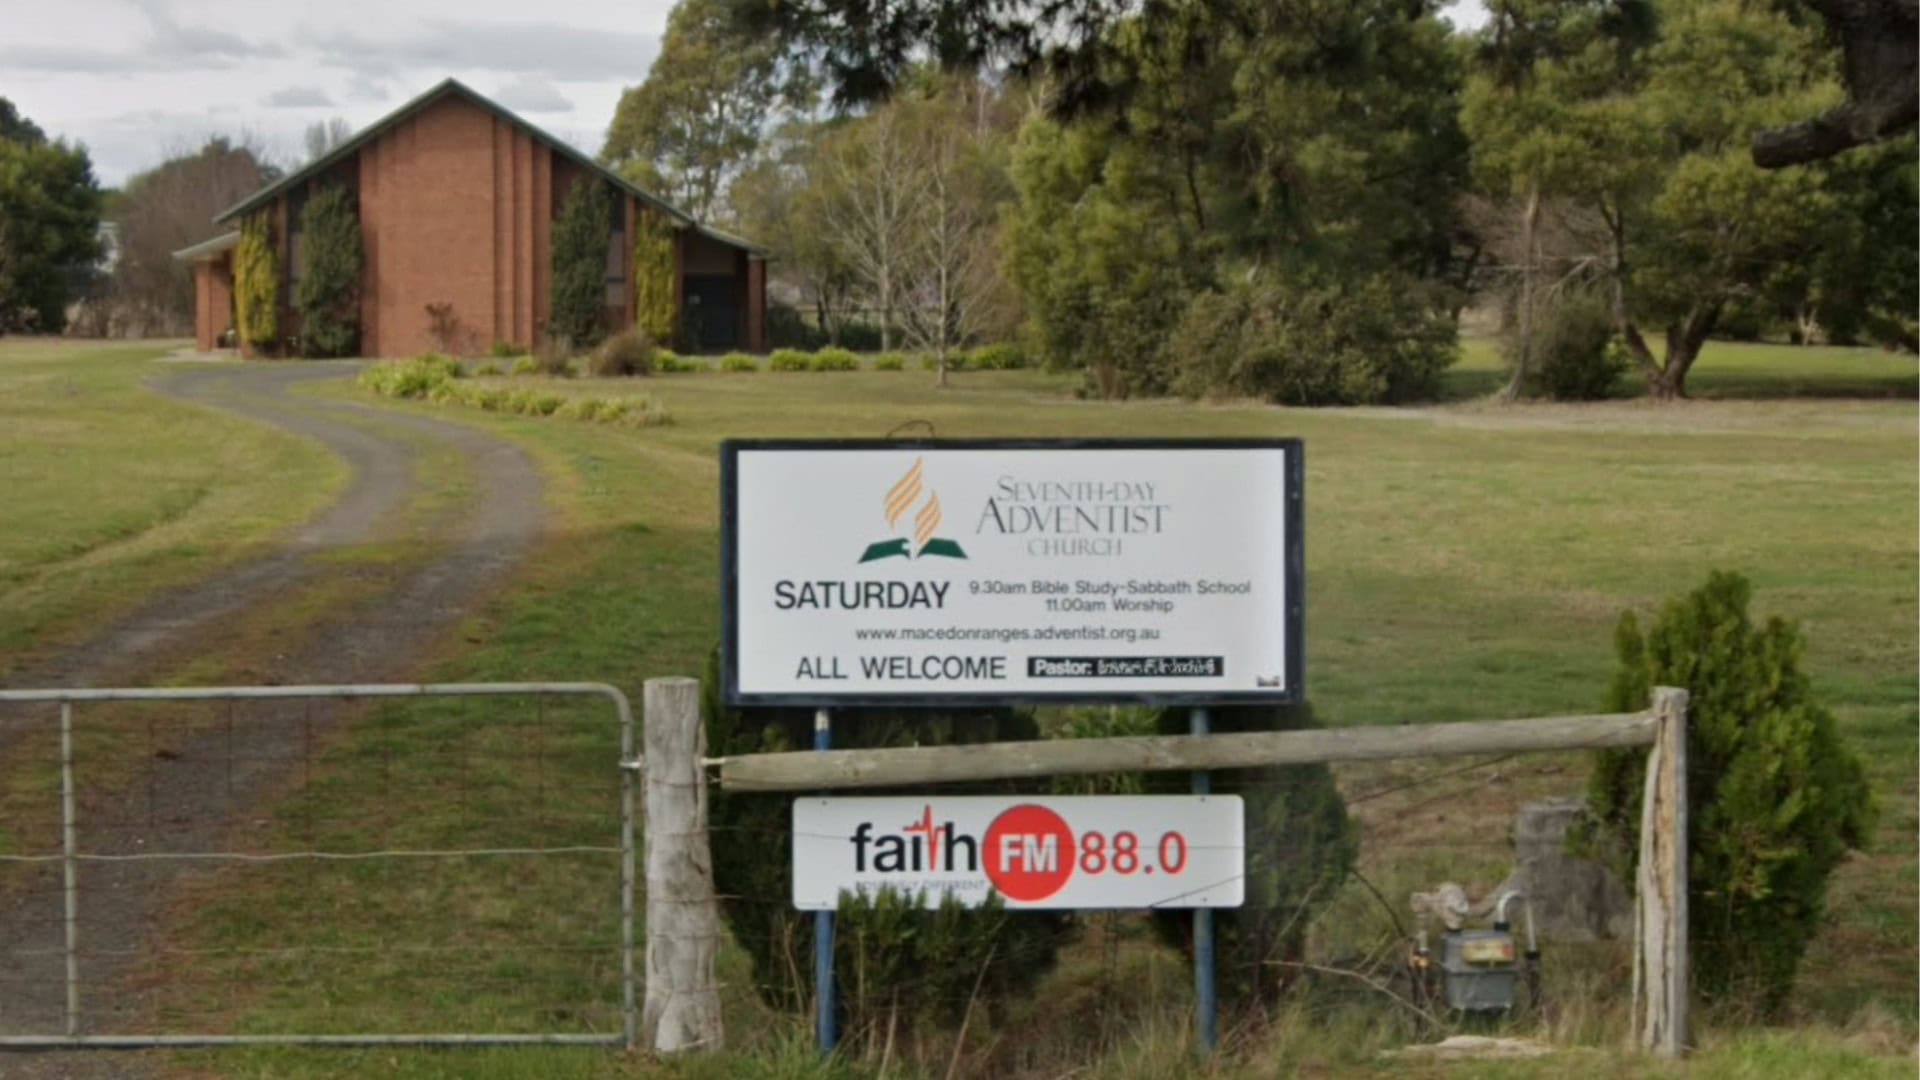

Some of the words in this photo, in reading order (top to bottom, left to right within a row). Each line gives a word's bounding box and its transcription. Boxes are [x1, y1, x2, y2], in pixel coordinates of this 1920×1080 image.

[975, 496, 1171, 535] ADVENTIST
[1027, 538, 1122, 556] CHURCH
[774, 579, 951, 610] SATURDAY
[969, 580, 1026, 595] 9.30am
[1031, 580, 1069, 595] Bible
[1196, 580, 1251, 595] School
[1045, 597, 1106, 612] 11.00am
[1112, 597, 1174, 613] Worship
[856, 626, 1160, 642] www.macedonranges.adventist.org.au
[795, 655, 848, 681] ALL
[860, 654, 1007, 681] WELCOME
[1034, 659, 1092, 676] Pastor:
[850, 803, 978, 873] faith
[999, 832, 1059, 874] FM
[1079, 830, 1188, 875] 88.0
